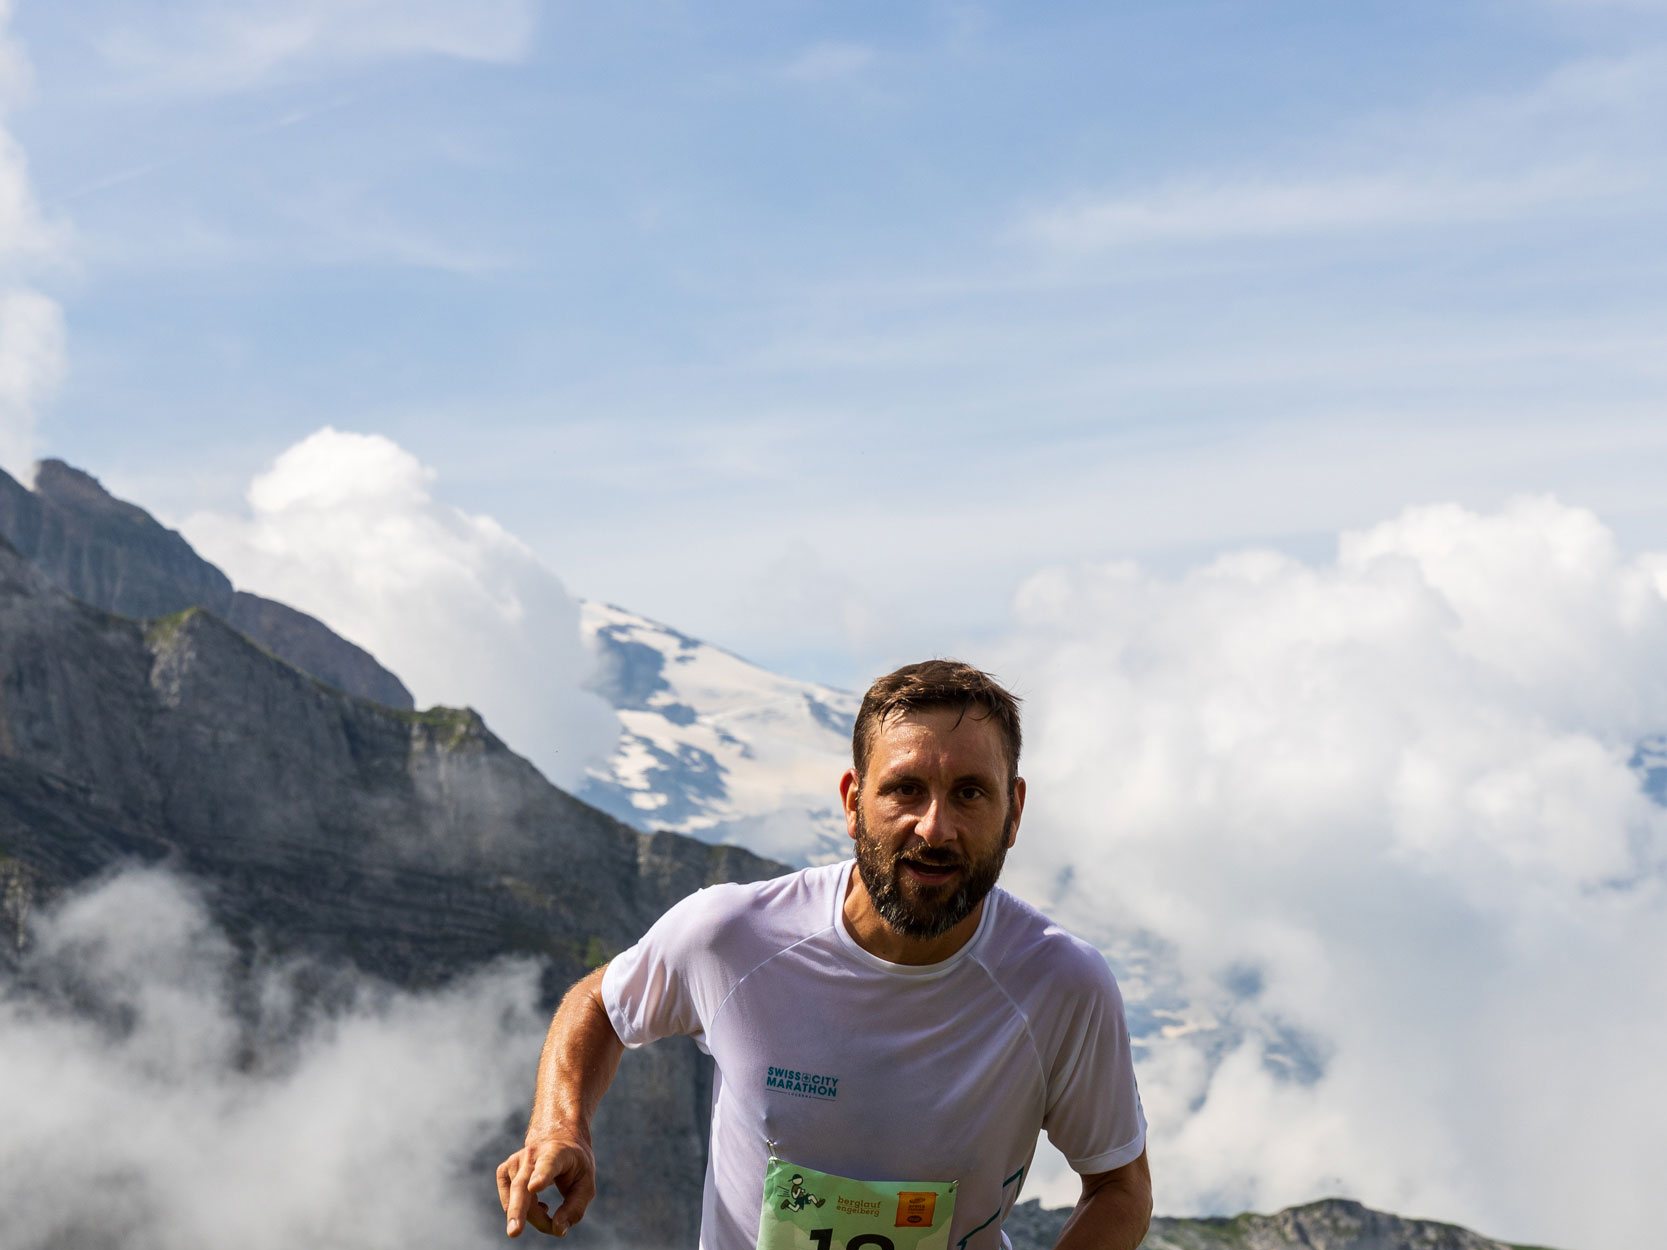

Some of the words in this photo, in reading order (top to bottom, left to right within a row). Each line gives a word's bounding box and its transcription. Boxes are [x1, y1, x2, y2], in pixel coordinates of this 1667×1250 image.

[767, 1066, 801, 1081] SWISS
[811, 1075, 839, 1087] CITY
[766, 1076, 837, 1097] MARATHON
[837, 1195, 881, 1209] berglauf
[836, 1205, 880, 1217] engelberg
